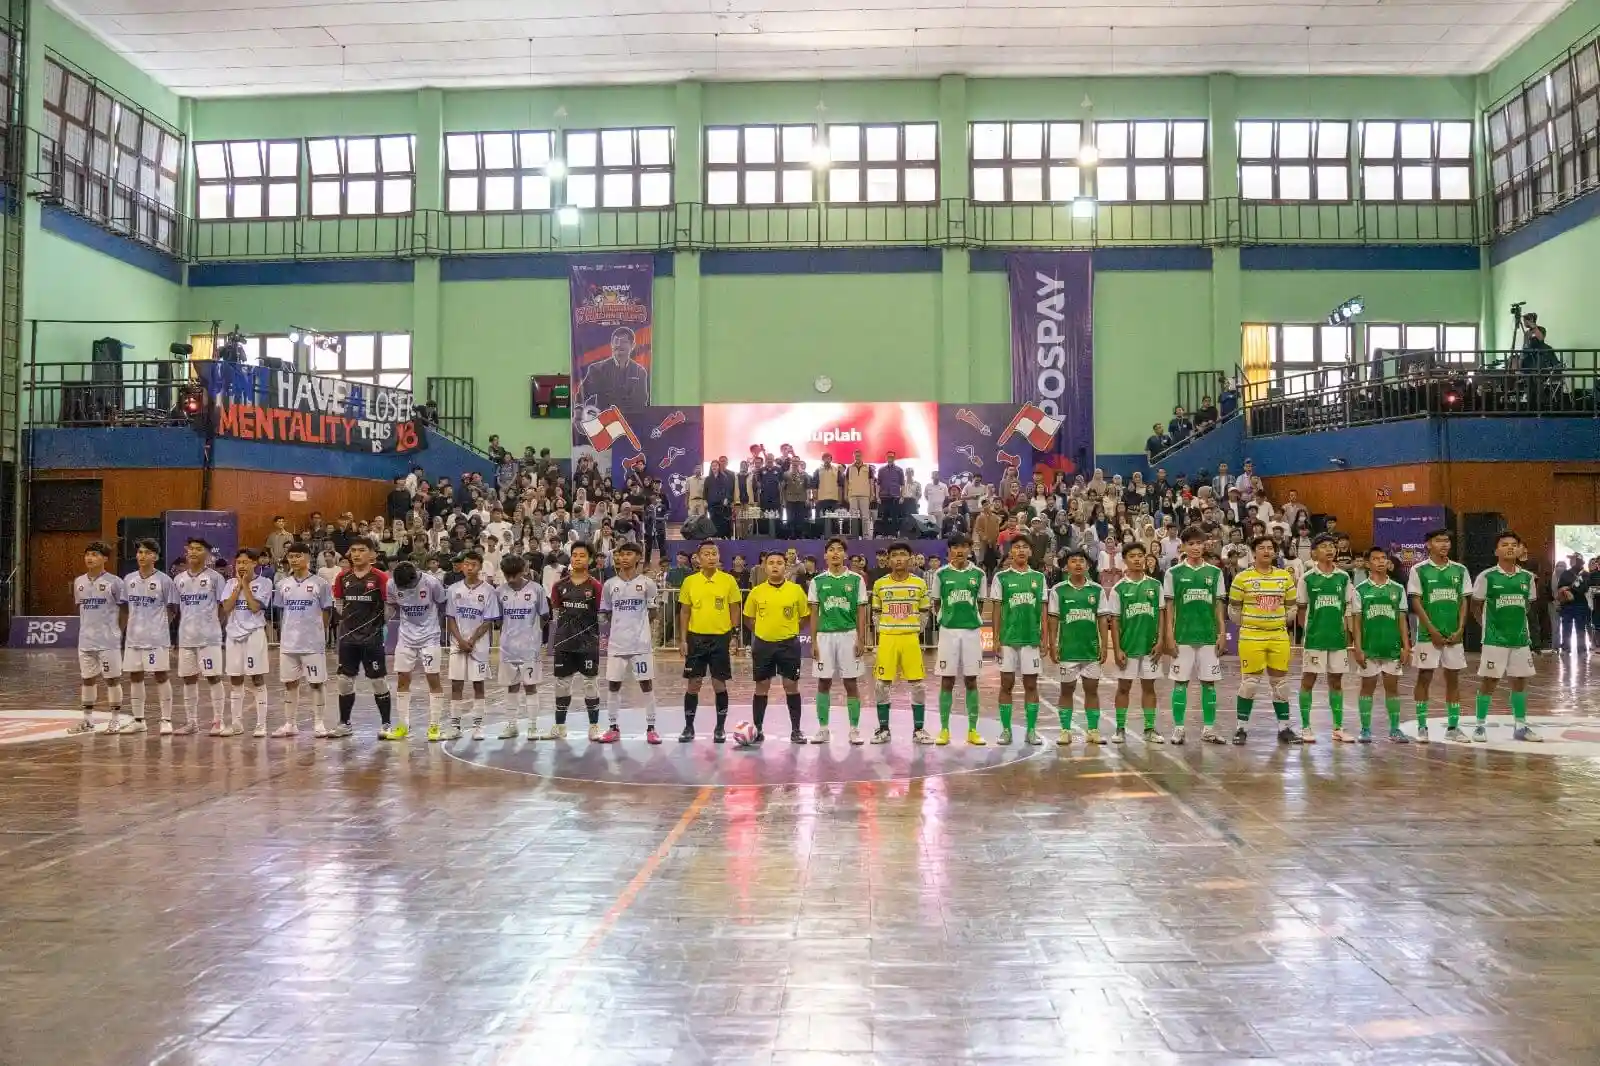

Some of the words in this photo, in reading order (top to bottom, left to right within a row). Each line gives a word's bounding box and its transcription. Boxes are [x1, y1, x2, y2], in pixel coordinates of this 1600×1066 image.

[1035, 271, 1066, 422] POSPAY
[277, 370, 346, 416] HAVE
[365, 388, 416, 422] LOSER
[217, 402, 357, 446] MENTALITY
[358, 420, 391, 440] THIS
[28, 621, 67, 633] POS
[149, 653, 155, 665] 8
[203, 658, 213, 670] 19
[247, 657, 254, 668] 9
[585, 660, 593, 669] 13
[306, 665, 317, 676] 14
[526, 667, 533, 678] 7
[635, 661, 647, 674] 10
